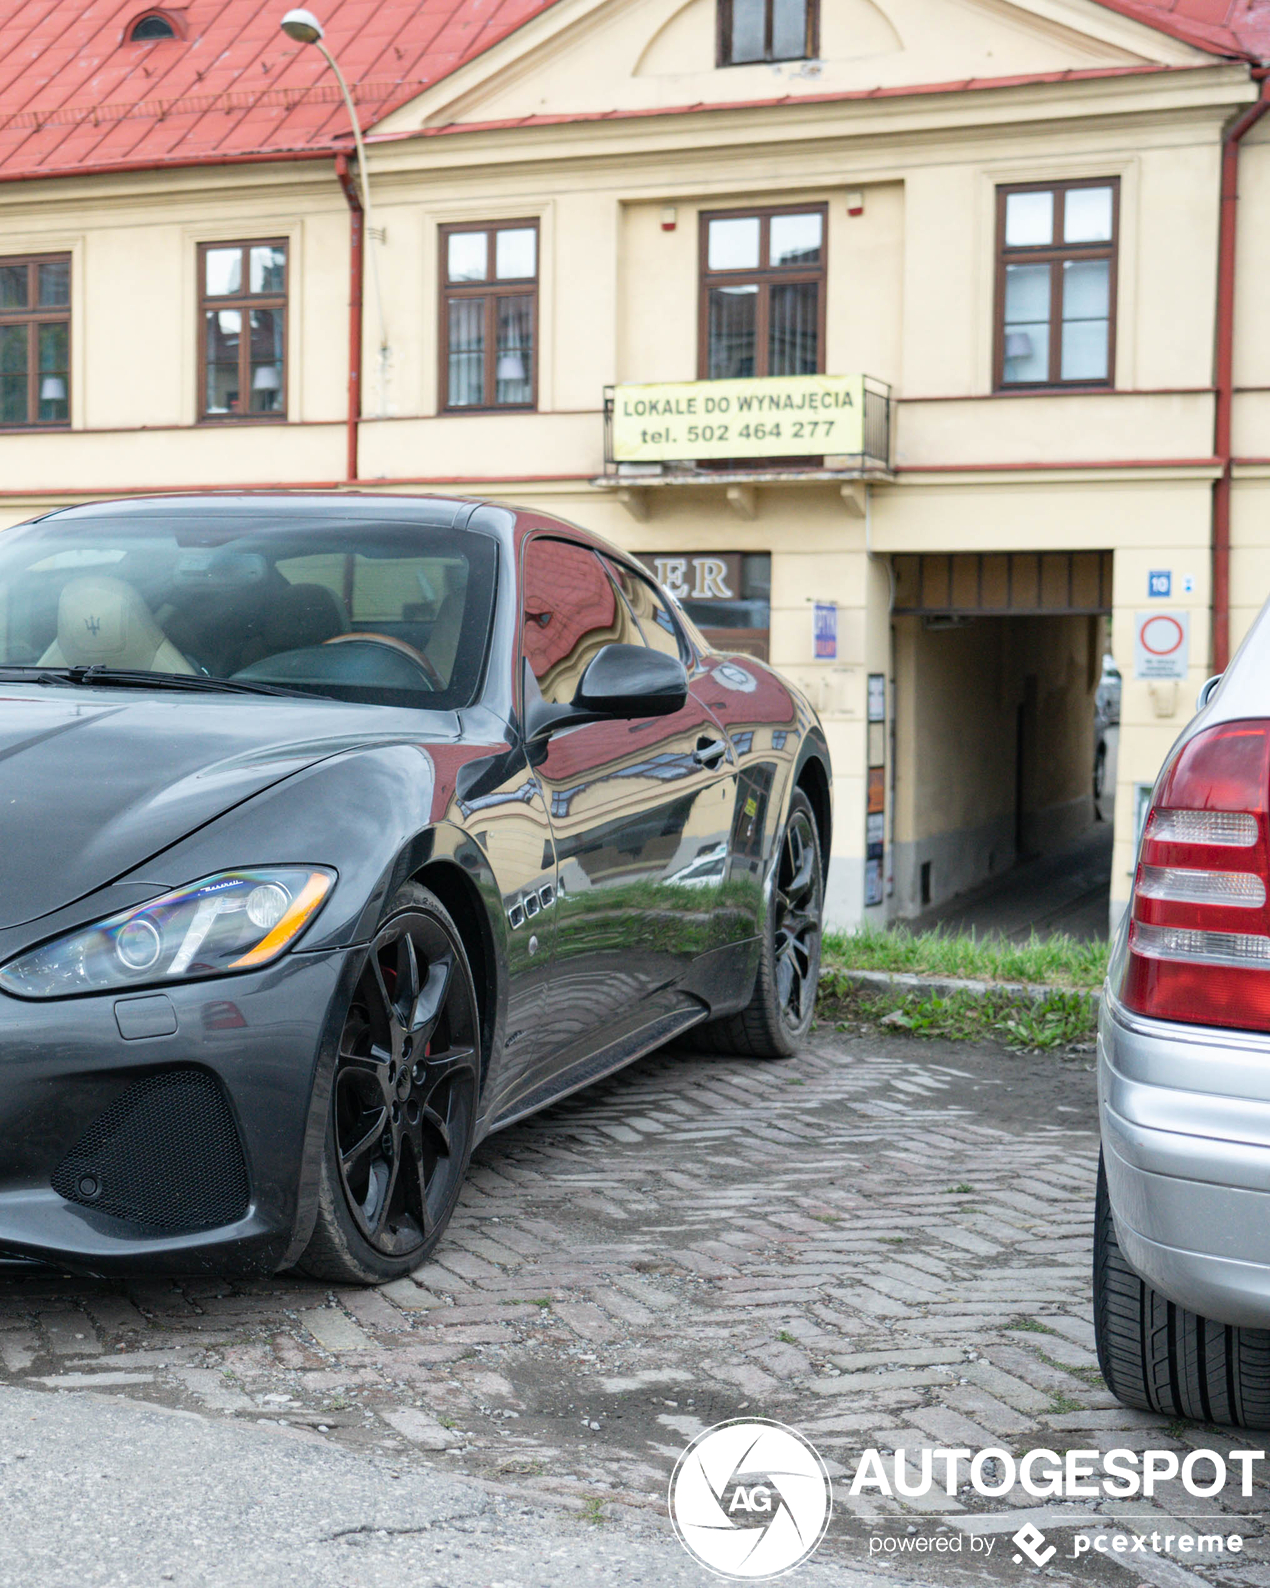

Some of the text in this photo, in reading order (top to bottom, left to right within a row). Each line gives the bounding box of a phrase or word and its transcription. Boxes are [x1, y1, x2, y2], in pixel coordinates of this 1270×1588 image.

[623, 390, 854, 417] LOKALE DO WYNAJĘCIA
[641, 420, 836, 444] tel. 502 464 277
[1151, 576, 1169, 593] 10
